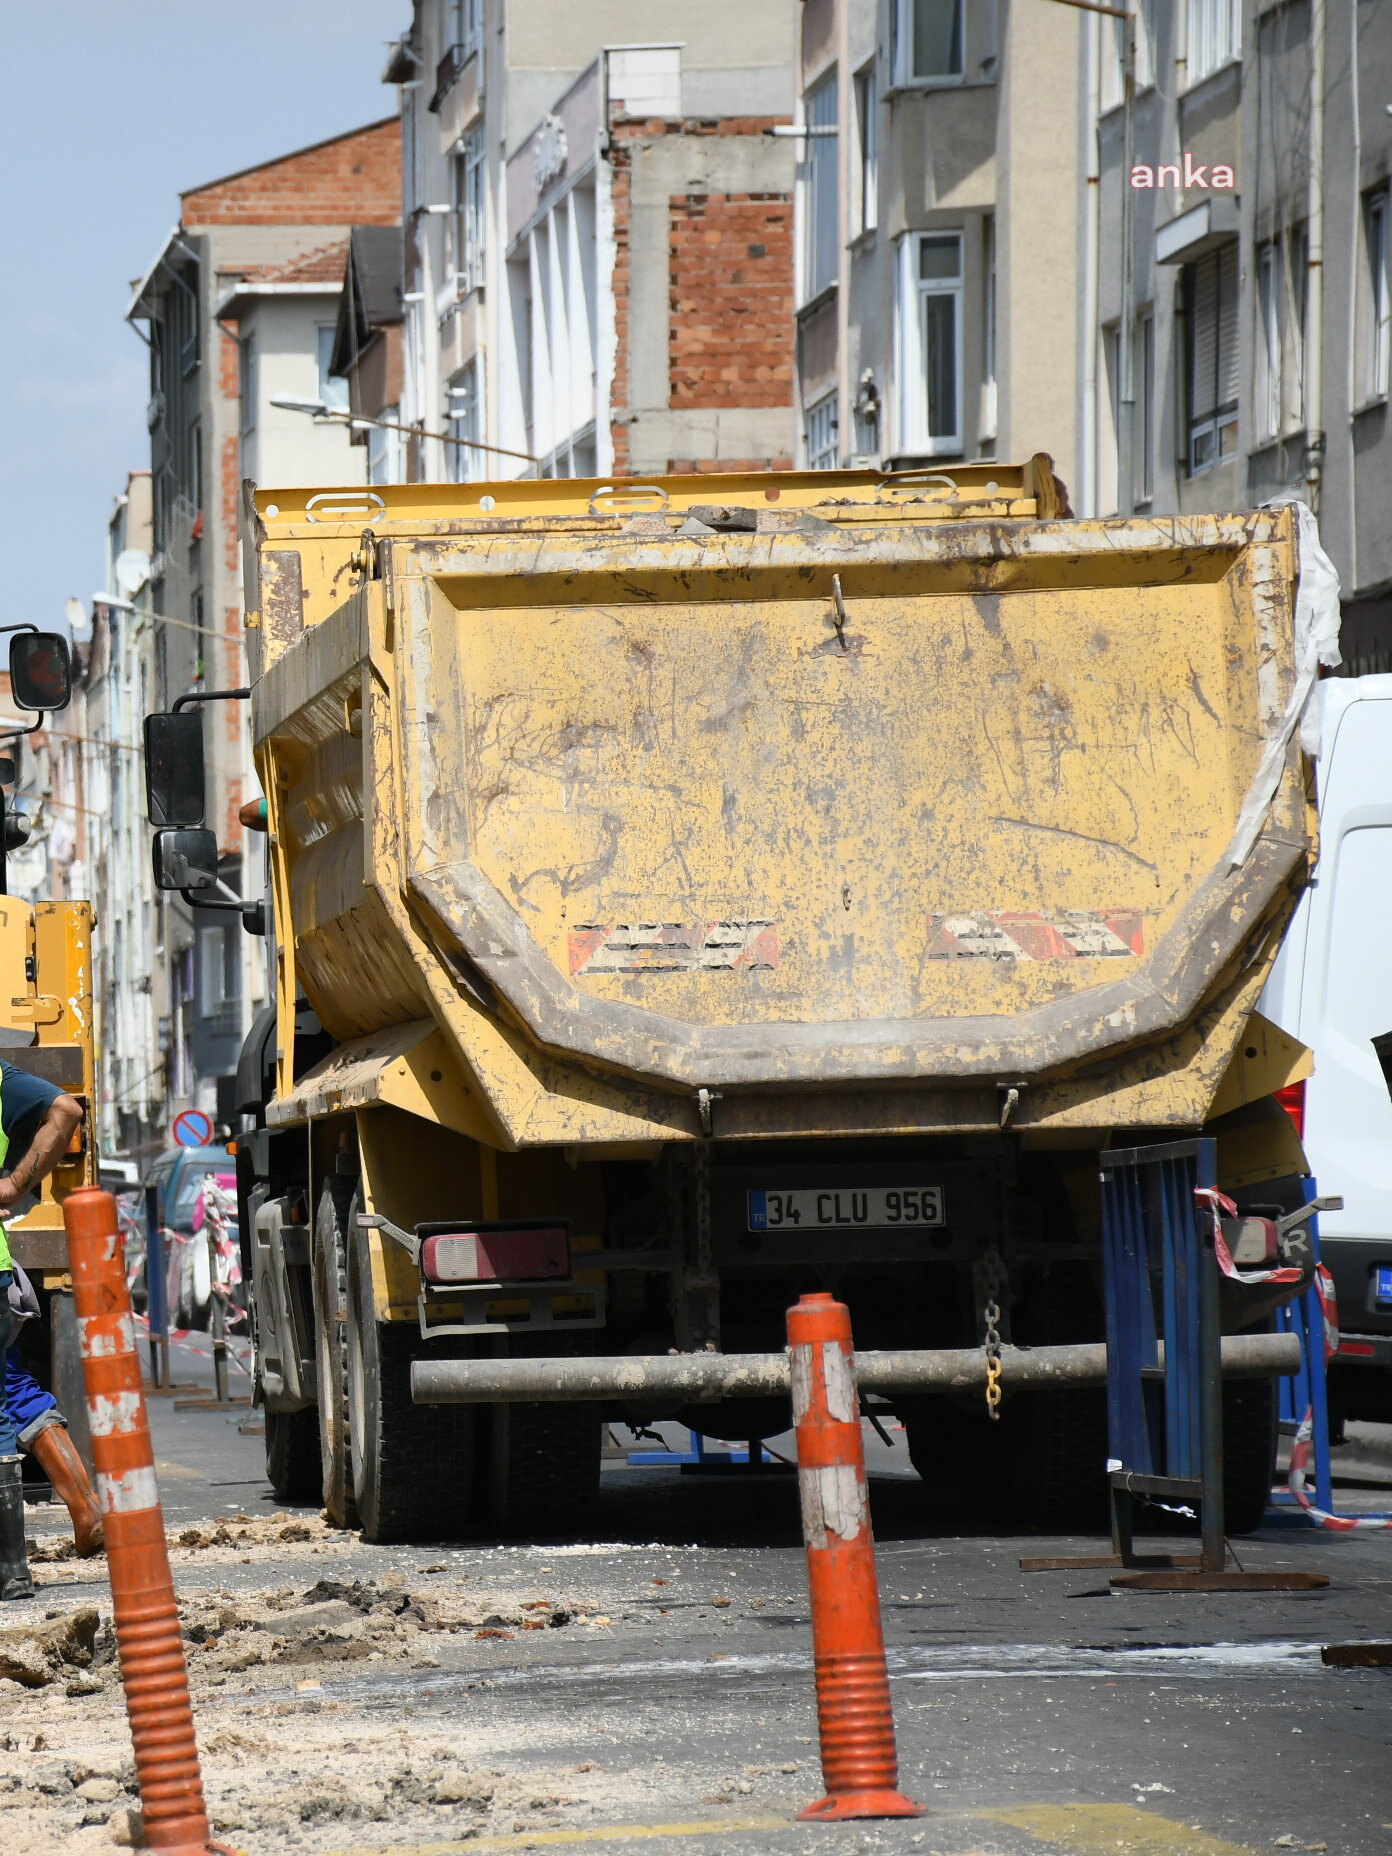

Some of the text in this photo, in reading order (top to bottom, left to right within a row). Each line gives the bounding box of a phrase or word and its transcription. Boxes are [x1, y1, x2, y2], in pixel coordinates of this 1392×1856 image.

[753, 1190, 938, 1225] TR 34 CLU 956
